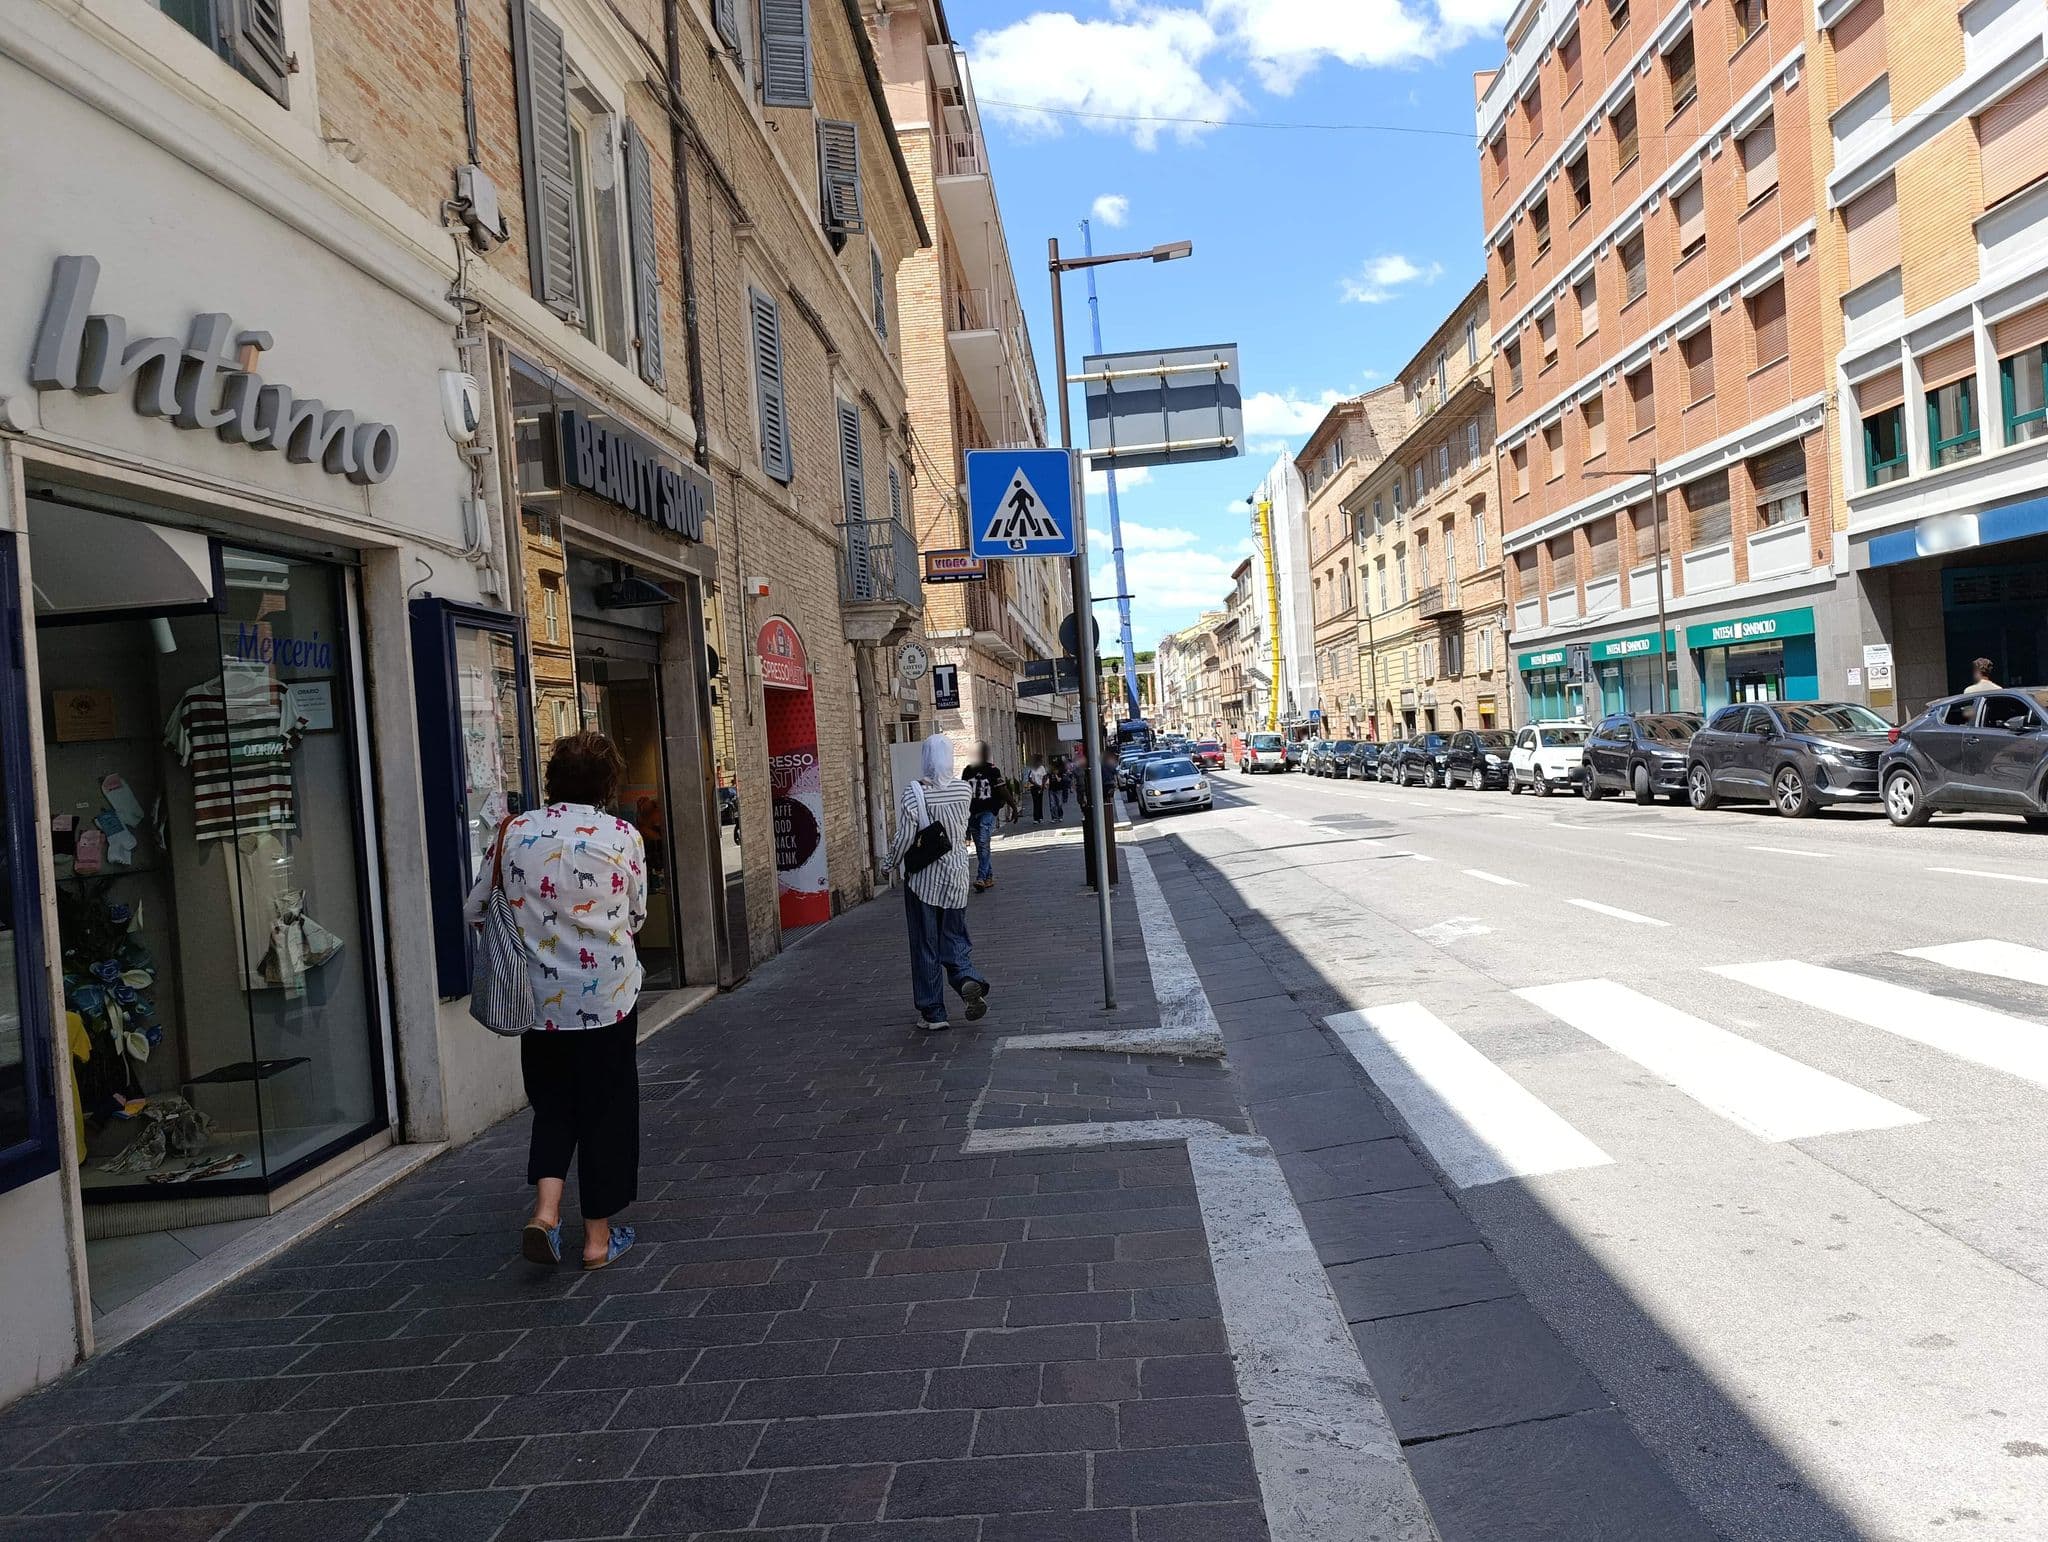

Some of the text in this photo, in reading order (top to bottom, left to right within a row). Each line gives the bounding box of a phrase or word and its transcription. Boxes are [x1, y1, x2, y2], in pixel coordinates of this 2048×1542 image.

[32, 255, 399, 485] Intimo
[574, 417, 706, 543] BEAUTY SHOP
[935, 558, 967, 568] VIDEO
[237, 622, 333, 670] Merceria
[936, 667, 954, 696] T
[769, 753, 813, 767] RESSO
[770, 767, 813, 788] ATIK
[775, 819, 792, 834] OOD
[777, 852, 798, 865] RINK
